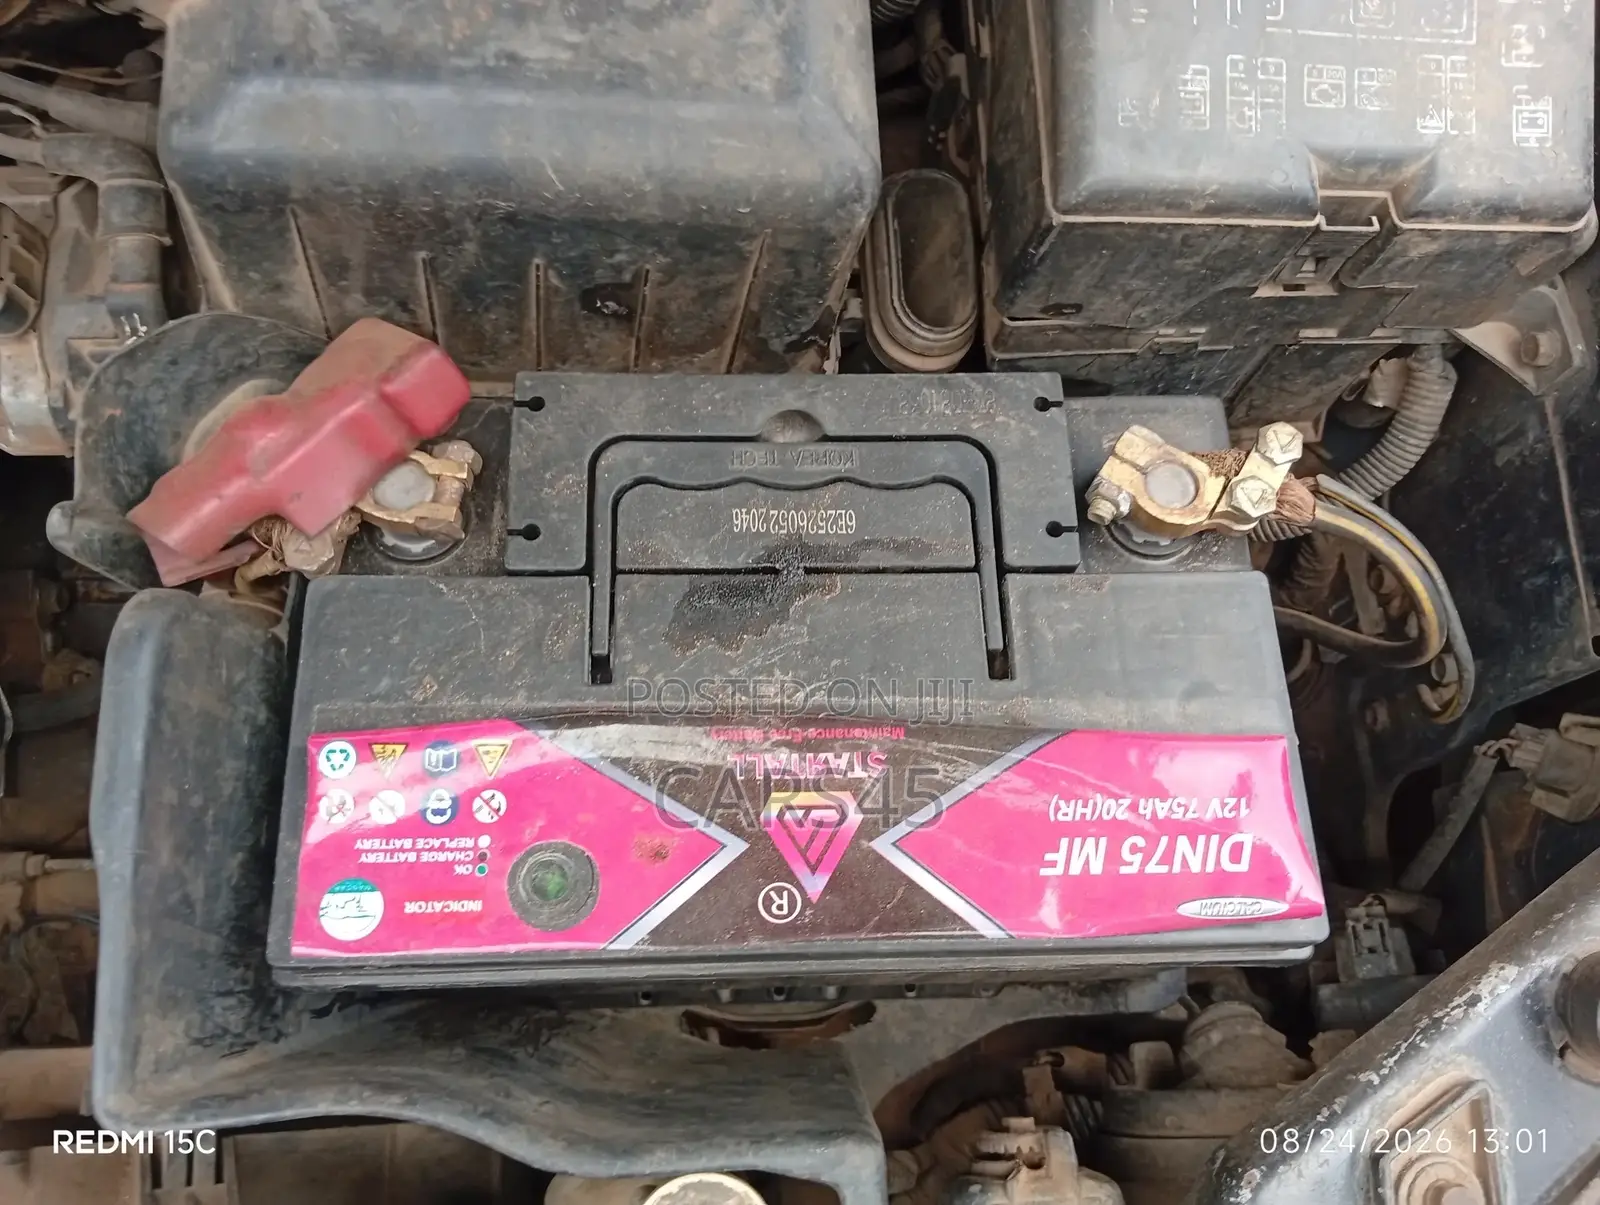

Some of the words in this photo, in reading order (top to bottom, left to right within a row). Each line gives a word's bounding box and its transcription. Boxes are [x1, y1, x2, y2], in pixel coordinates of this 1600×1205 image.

[731, 449, 780, 470] TECH
[789, 449, 857, 470] KOREA
[1047, 794, 1131, 822] 20(HR)
[1138, 796, 1199, 820] 75Ah
[1204, 796, 1251, 819] 12V
[354, 837, 413, 850] BATTERY
[414, 837, 476, 849] REPLACE
[357, 851, 417, 863] BATTERY
[419, 850, 474, 862] CHARGE
[1040, 835, 1107, 876] MF
[1119, 832, 1255, 876] DIN75
[452, 863, 474, 876] OK
[403, 899, 483, 914] INDICATOR
[1199, 900, 1264, 917] CALCIUM
